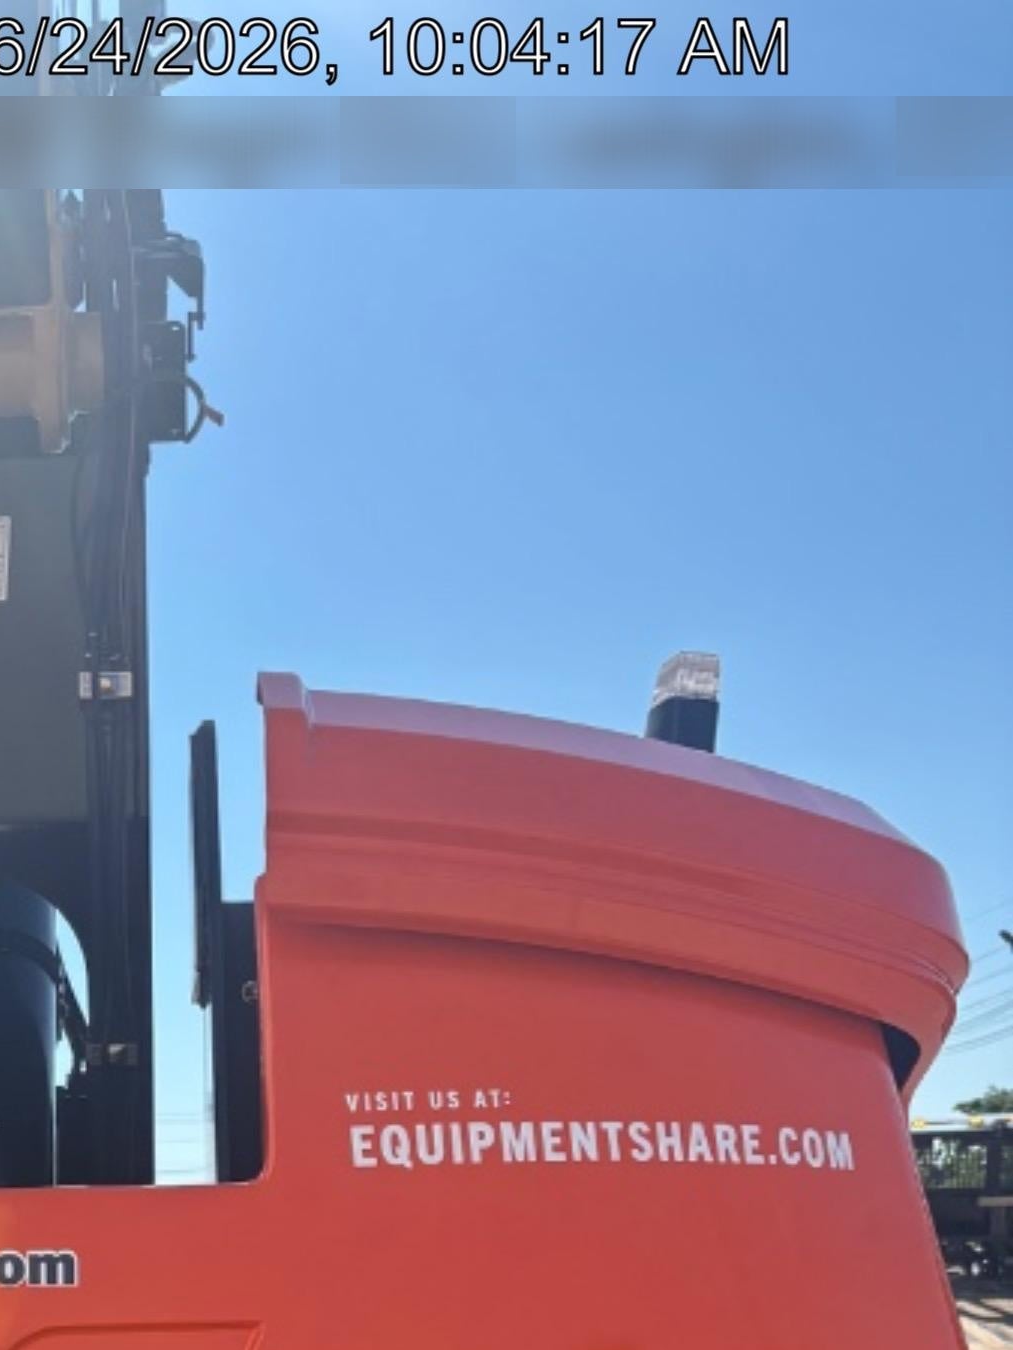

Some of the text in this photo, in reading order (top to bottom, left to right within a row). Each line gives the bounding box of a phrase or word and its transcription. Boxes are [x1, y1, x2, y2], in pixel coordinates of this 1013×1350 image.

[345, 1090, 511, 1112] VISIT US AT:
[349, 1121, 855, 1170] EQUIPMENTSHARE.COM
